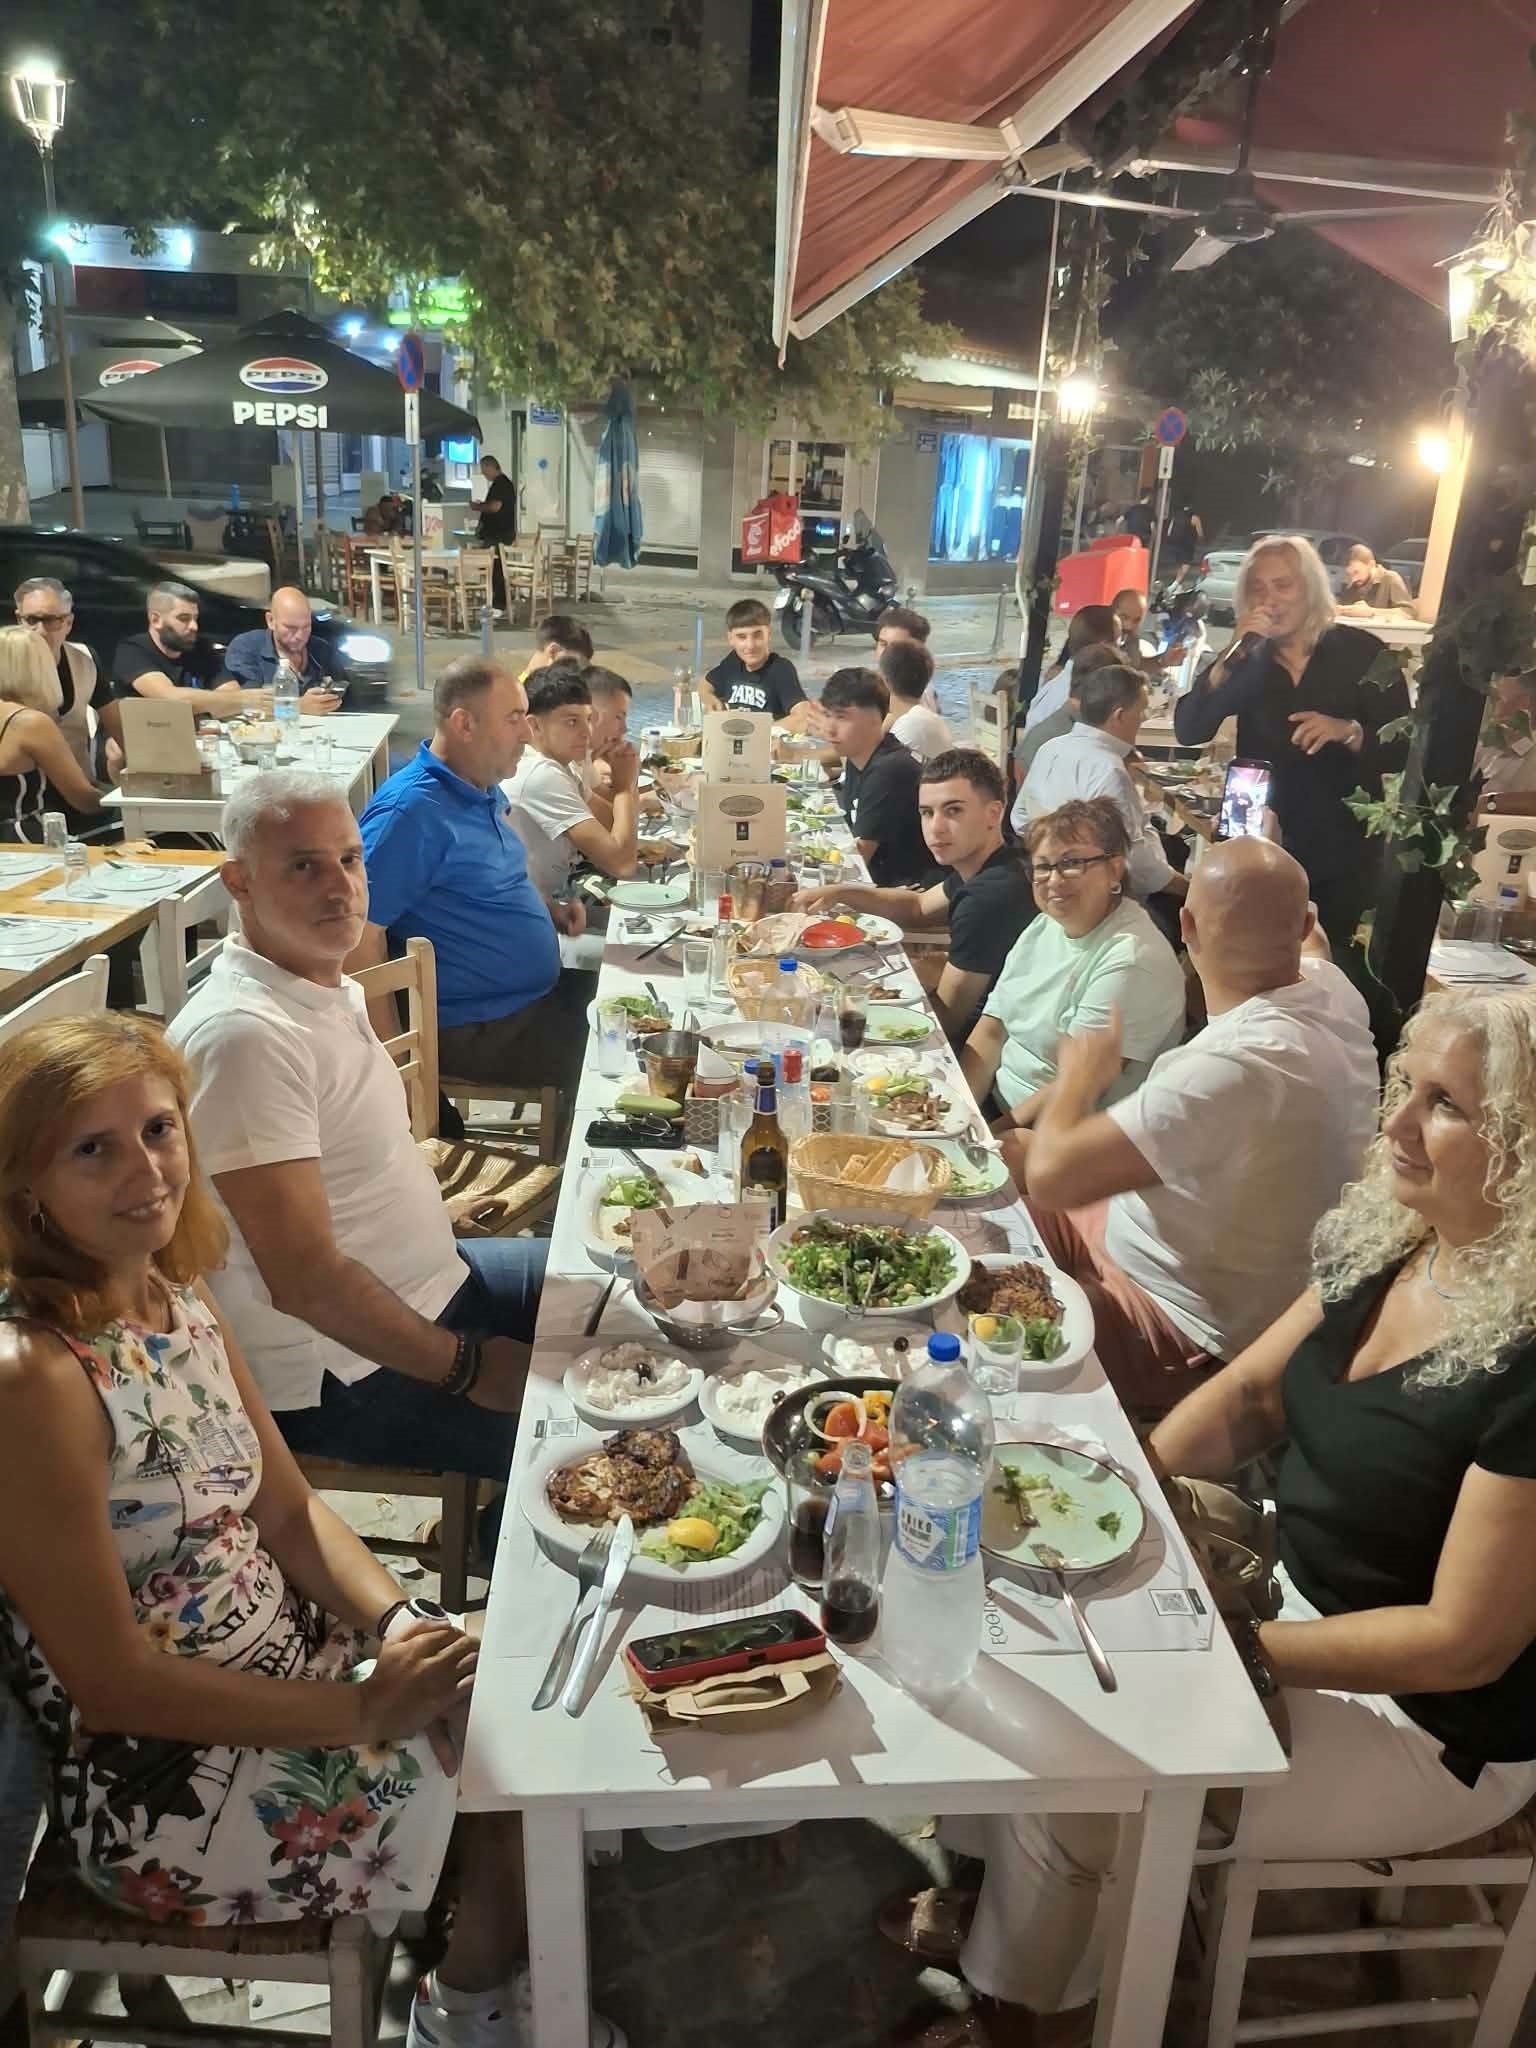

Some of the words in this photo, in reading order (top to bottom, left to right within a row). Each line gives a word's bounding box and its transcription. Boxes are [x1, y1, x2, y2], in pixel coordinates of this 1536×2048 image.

[246, 371, 322, 382] PEPSI
[232, 401, 328, 429] PEPSI
[769, 518, 801, 556] efood
